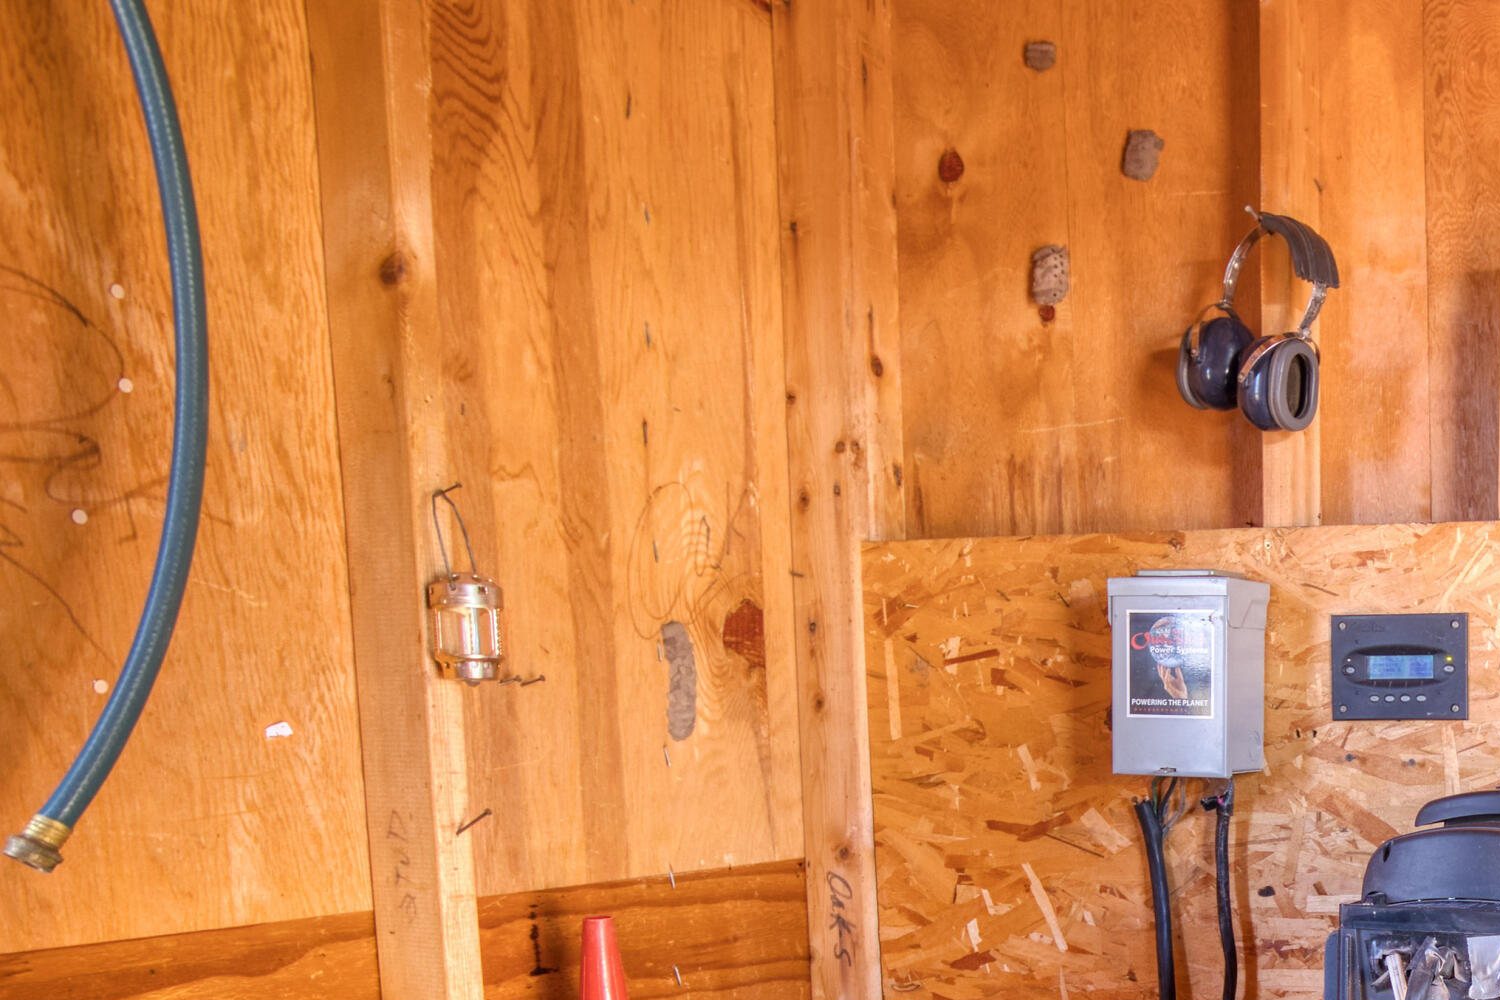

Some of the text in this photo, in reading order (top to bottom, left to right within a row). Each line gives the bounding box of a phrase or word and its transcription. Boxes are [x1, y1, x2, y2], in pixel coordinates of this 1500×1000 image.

[1150, 645, 1175, 655] Power
[1131, 698, 1209, 707] POWERING THE PLANET
